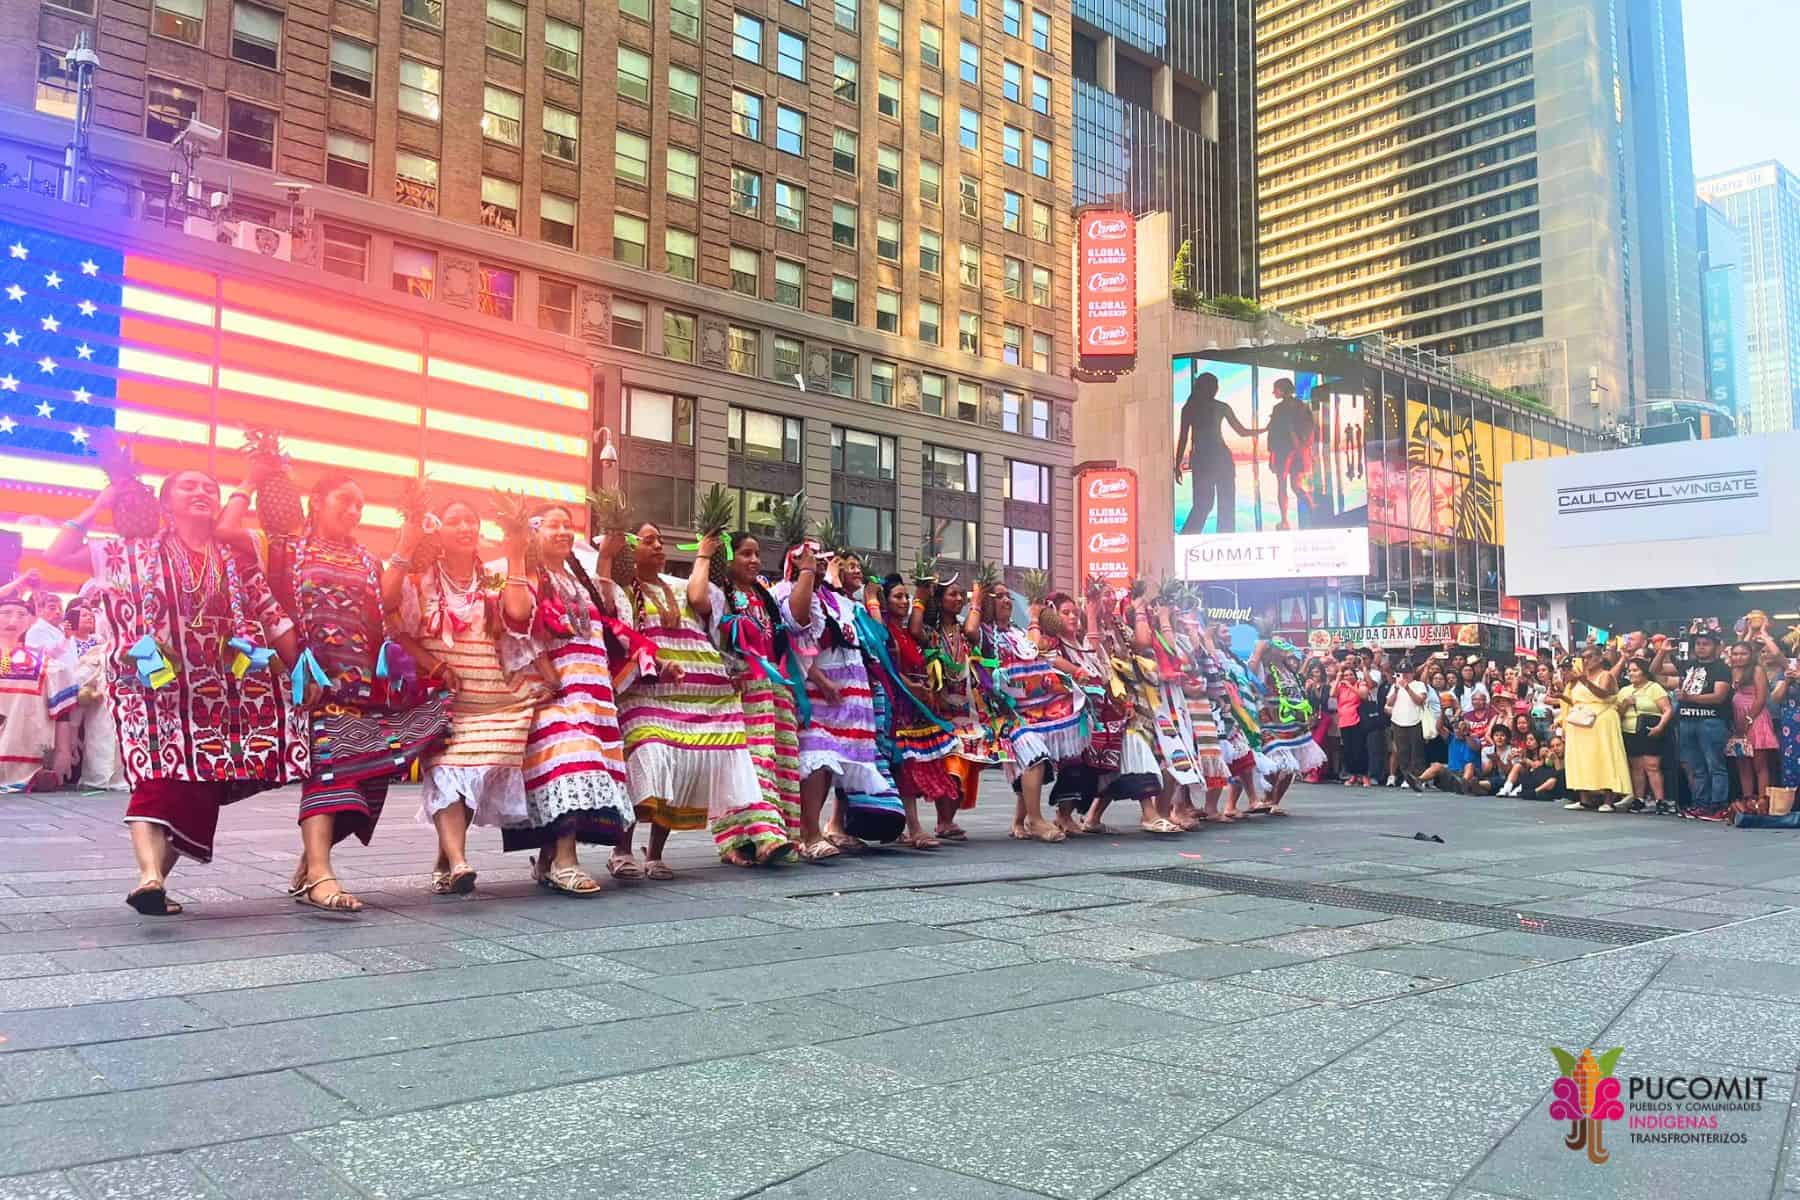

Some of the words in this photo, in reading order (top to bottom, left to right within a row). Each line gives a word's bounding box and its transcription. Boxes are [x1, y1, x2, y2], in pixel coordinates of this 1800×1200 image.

[1088, 247, 1127, 257] GLOBAL
[1088, 257, 1127, 265] FLAGSHIP
[1088, 301, 1127, 310] GLOBAL
[1088, 310, 1127, 318] FLAGSHIP
[1089, 507, 1128, 516] GLOBAL
[1089, 516, 1128, 524] FLAGSHIP
[1189, 545, 1280, 562] SUMMIT
[1089, 561, 1129, 571] GLOBAL
